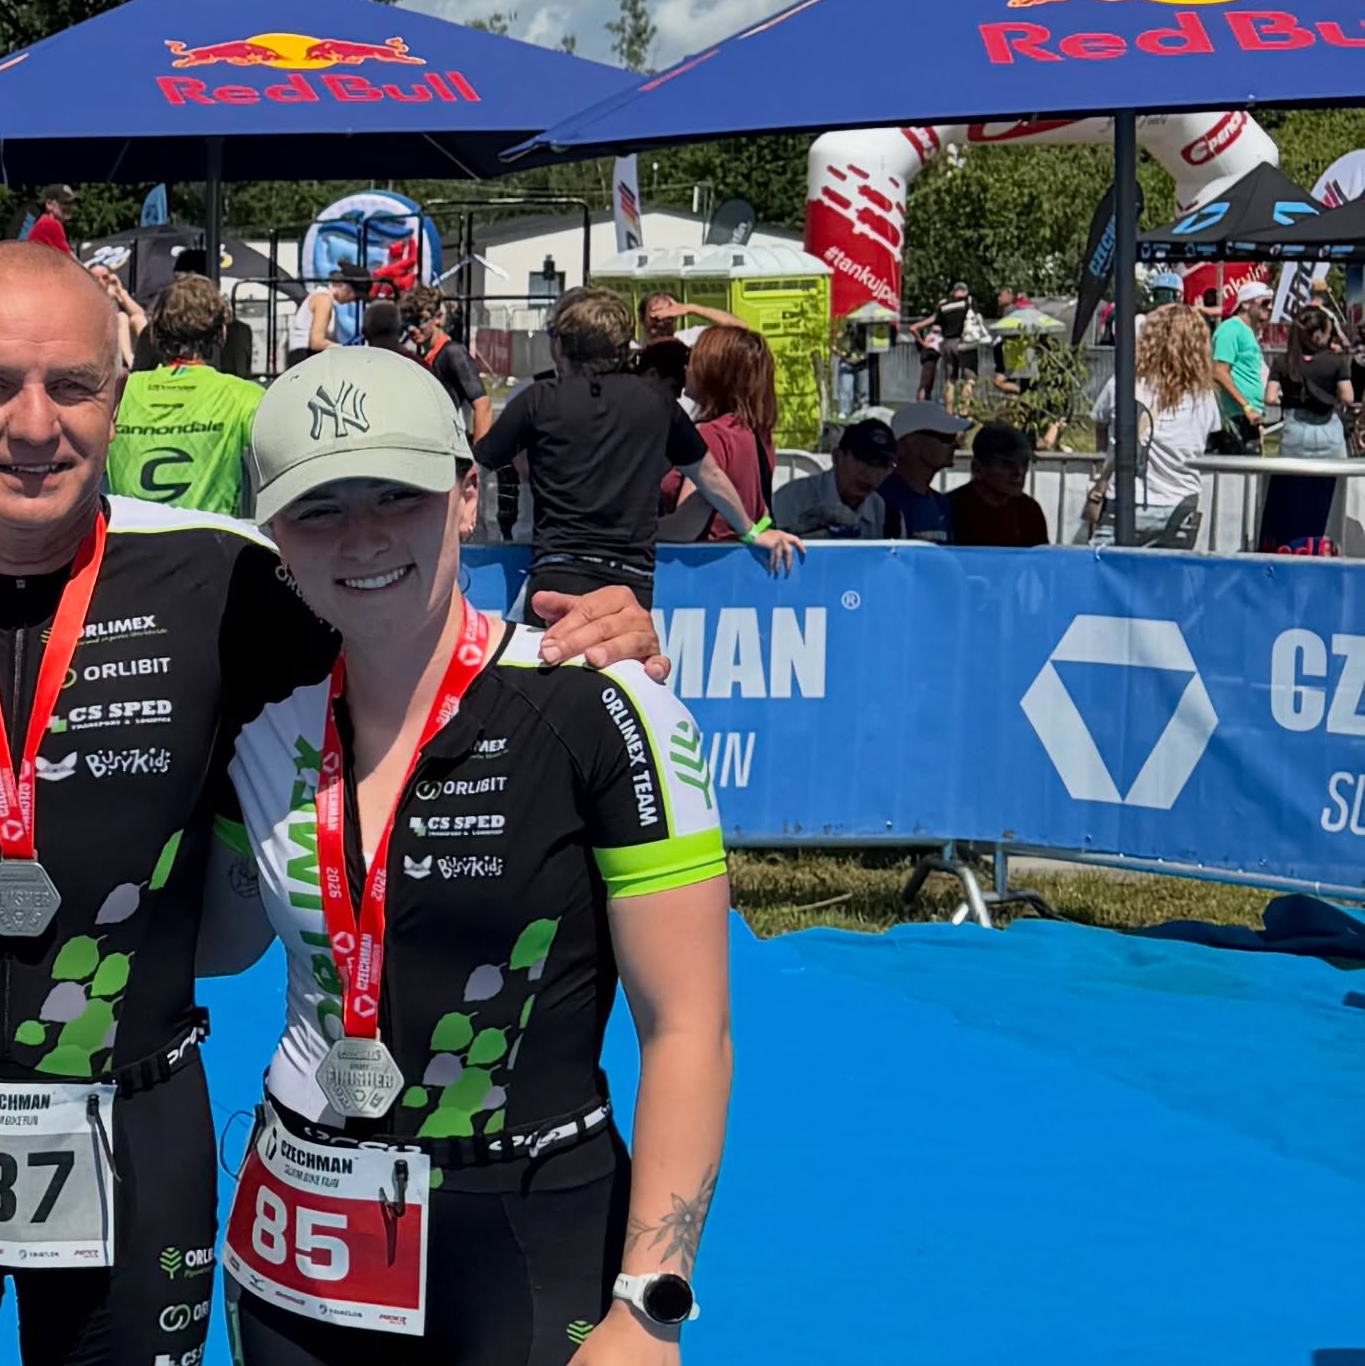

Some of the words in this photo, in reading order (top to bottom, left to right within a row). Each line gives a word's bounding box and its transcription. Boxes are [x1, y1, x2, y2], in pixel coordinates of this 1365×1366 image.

[978, 12, 1212, 65] Red
[155, 74, 318, 106] Red
[329, 71, 481, 103] Bull
[84, 657, 171, 681] ORLIBIT
[69, 705, 102, 722] CS
[109, 700, 172, 718] SPED
[602, 687, 647, 768] ORLIMEX
[632, 770, 658, 827] TEAM
[443, 776, 508, 795] ORLIBIT
[428, 817, 451, 830] CS
[454, 815, 506, 830] SPED
[325, 867, 342, 899] 2026
[280, 1139, 354, 1175] CZECHMAN
[251, 1184, 350, 1281] 85
